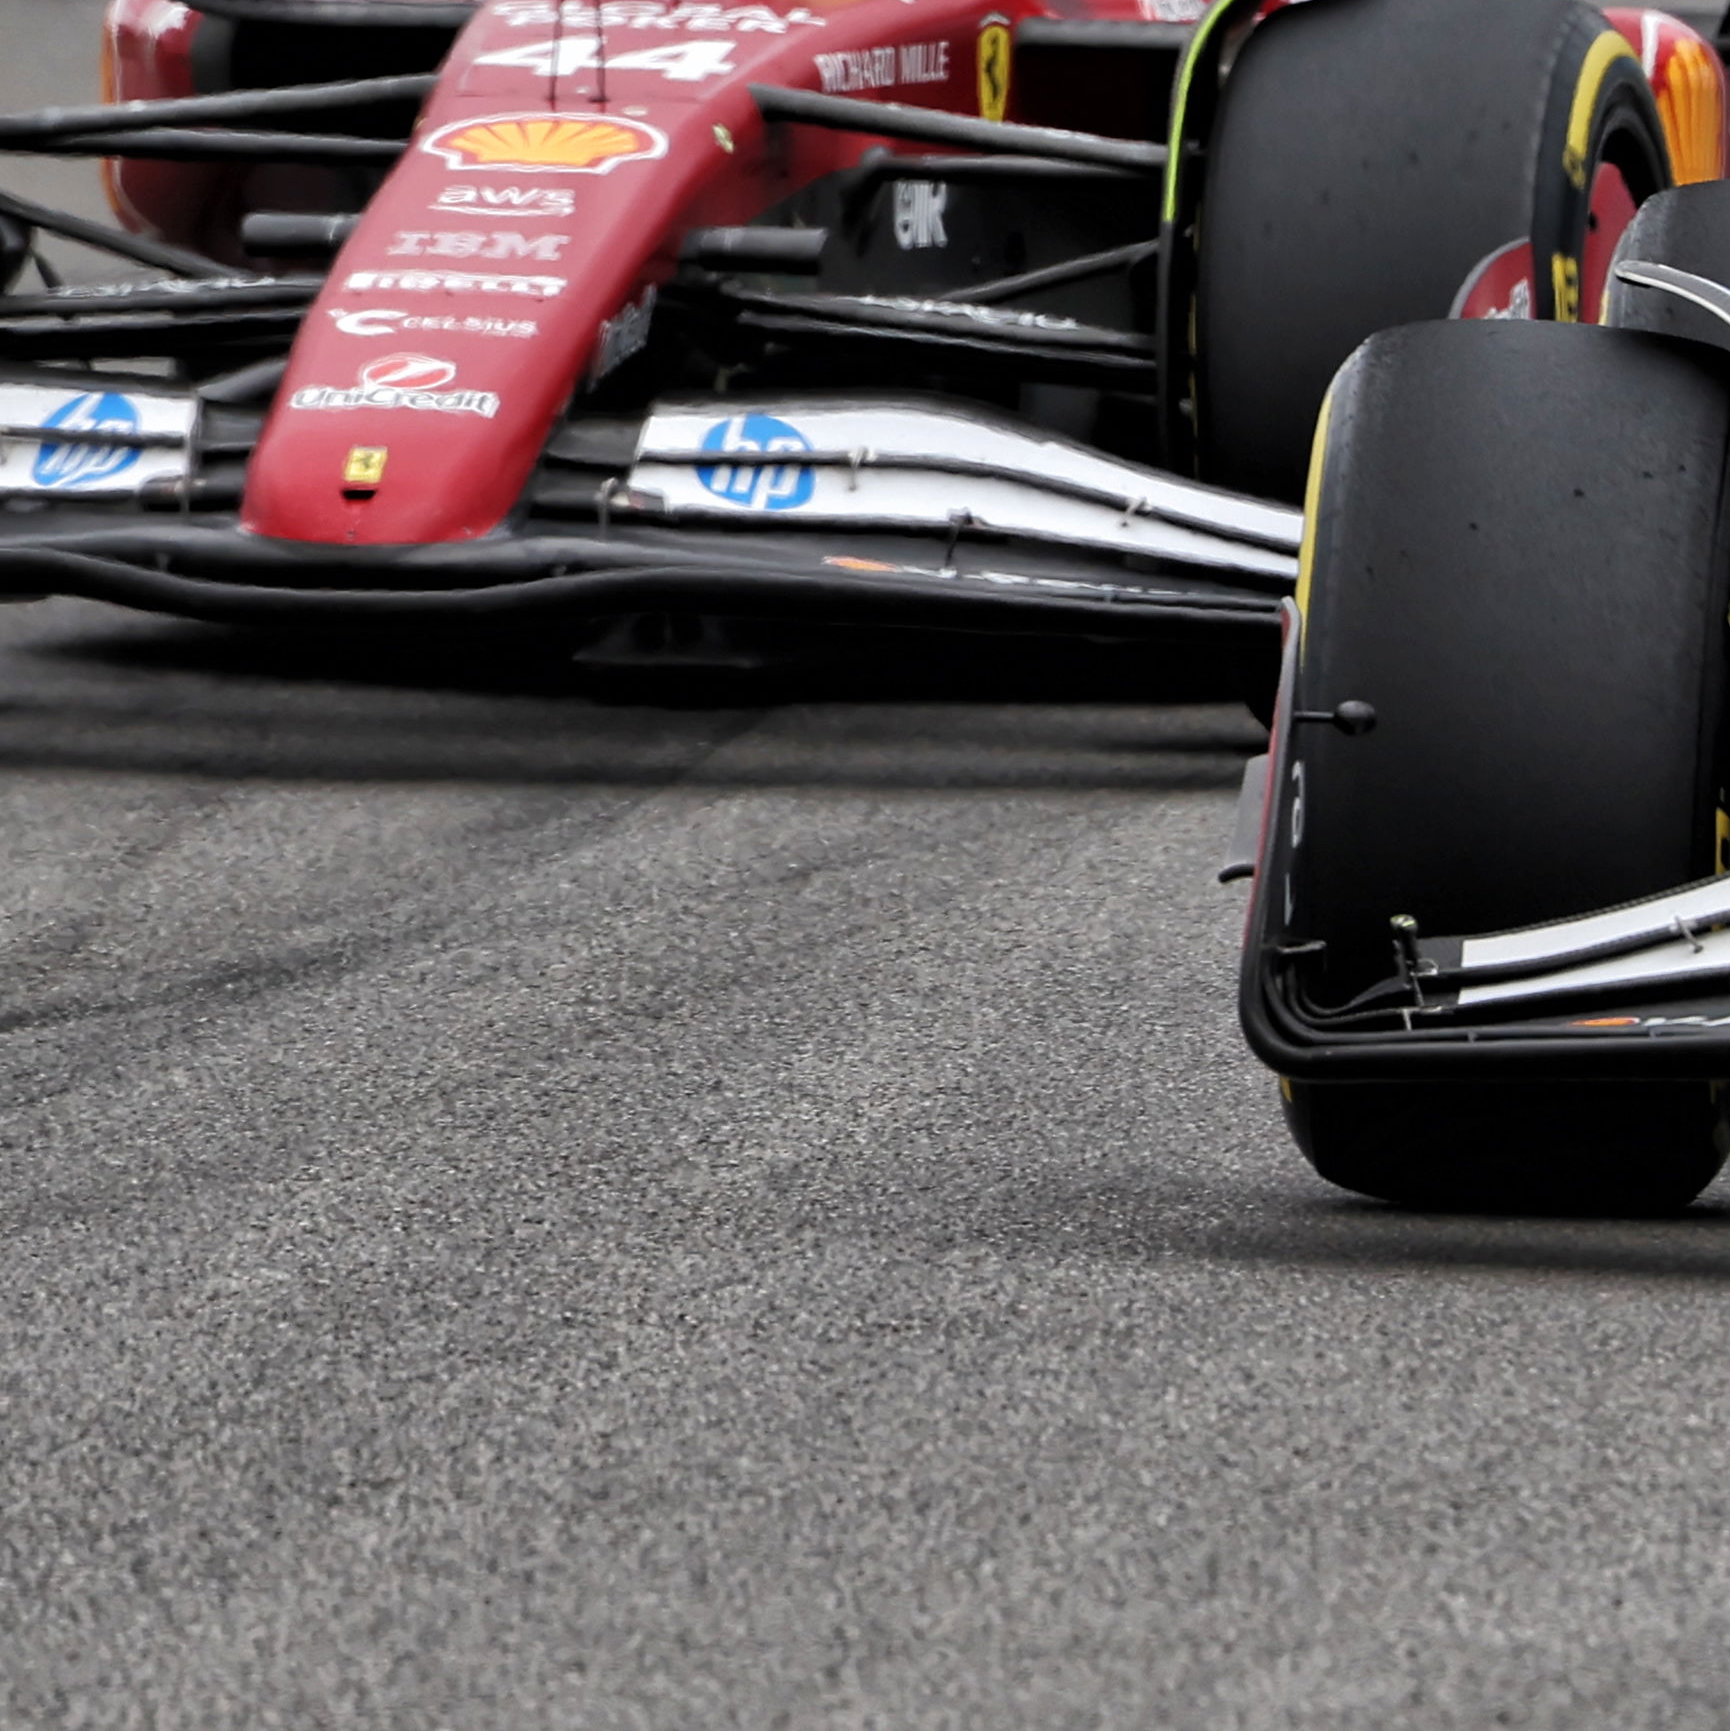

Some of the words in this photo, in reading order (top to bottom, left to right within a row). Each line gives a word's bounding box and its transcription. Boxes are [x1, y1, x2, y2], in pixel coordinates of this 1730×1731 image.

[473, 34, 736, 81] 44
[386, 231, 572, 261] IBM
[342, 270, 568, 297] PIRELLI
[292, 387, 498, 416] UniCredit
